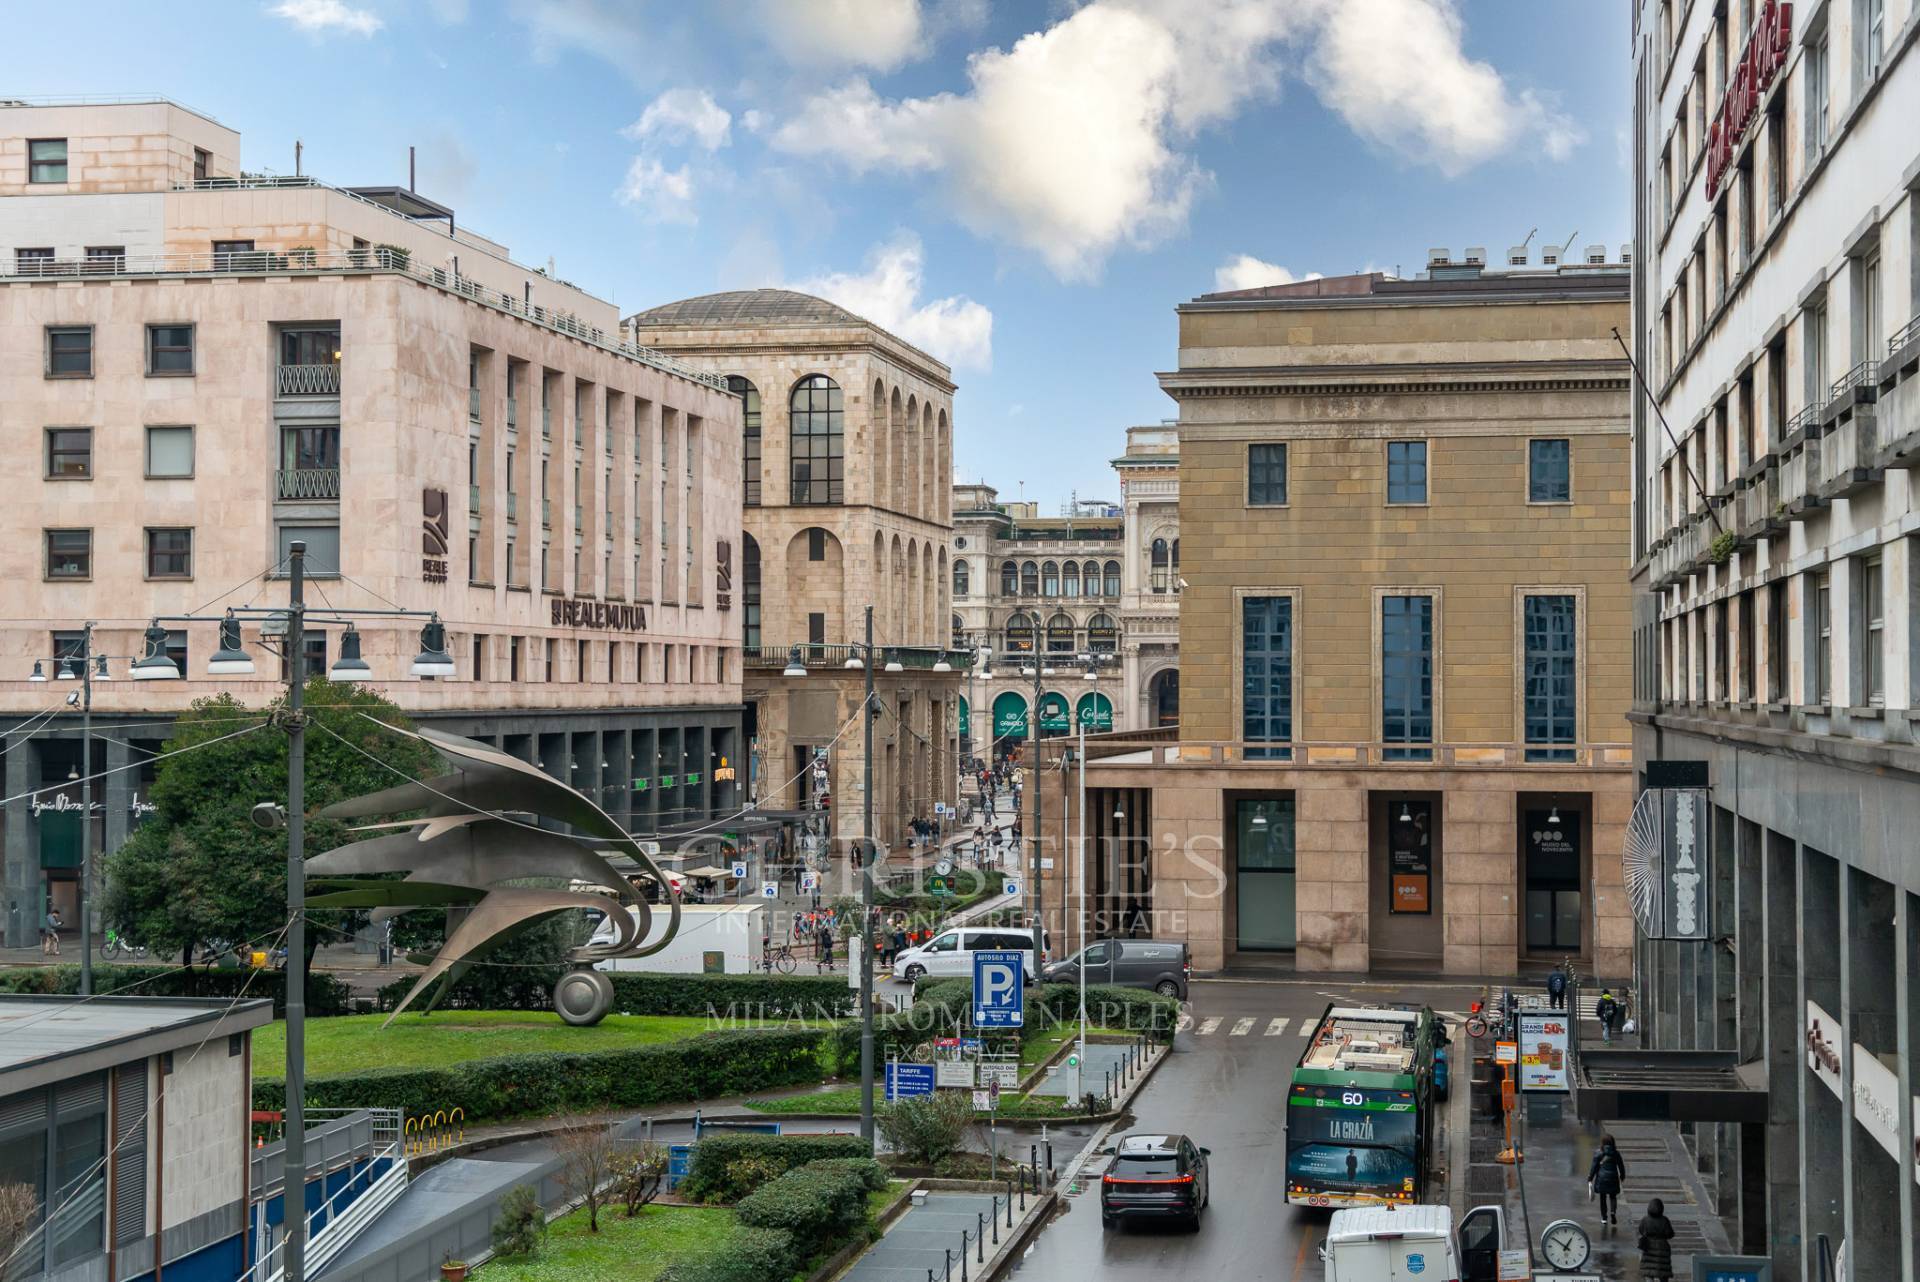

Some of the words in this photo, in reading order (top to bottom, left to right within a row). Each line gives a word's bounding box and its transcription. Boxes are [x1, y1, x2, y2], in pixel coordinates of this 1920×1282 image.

[982, 964, 1014, 1006] P
[1342, 1092, 1363, 1106] 60
[1330, 1120, 1341, 1139] LA
[1342, 1121, 1374, 1140] GRAZIA
